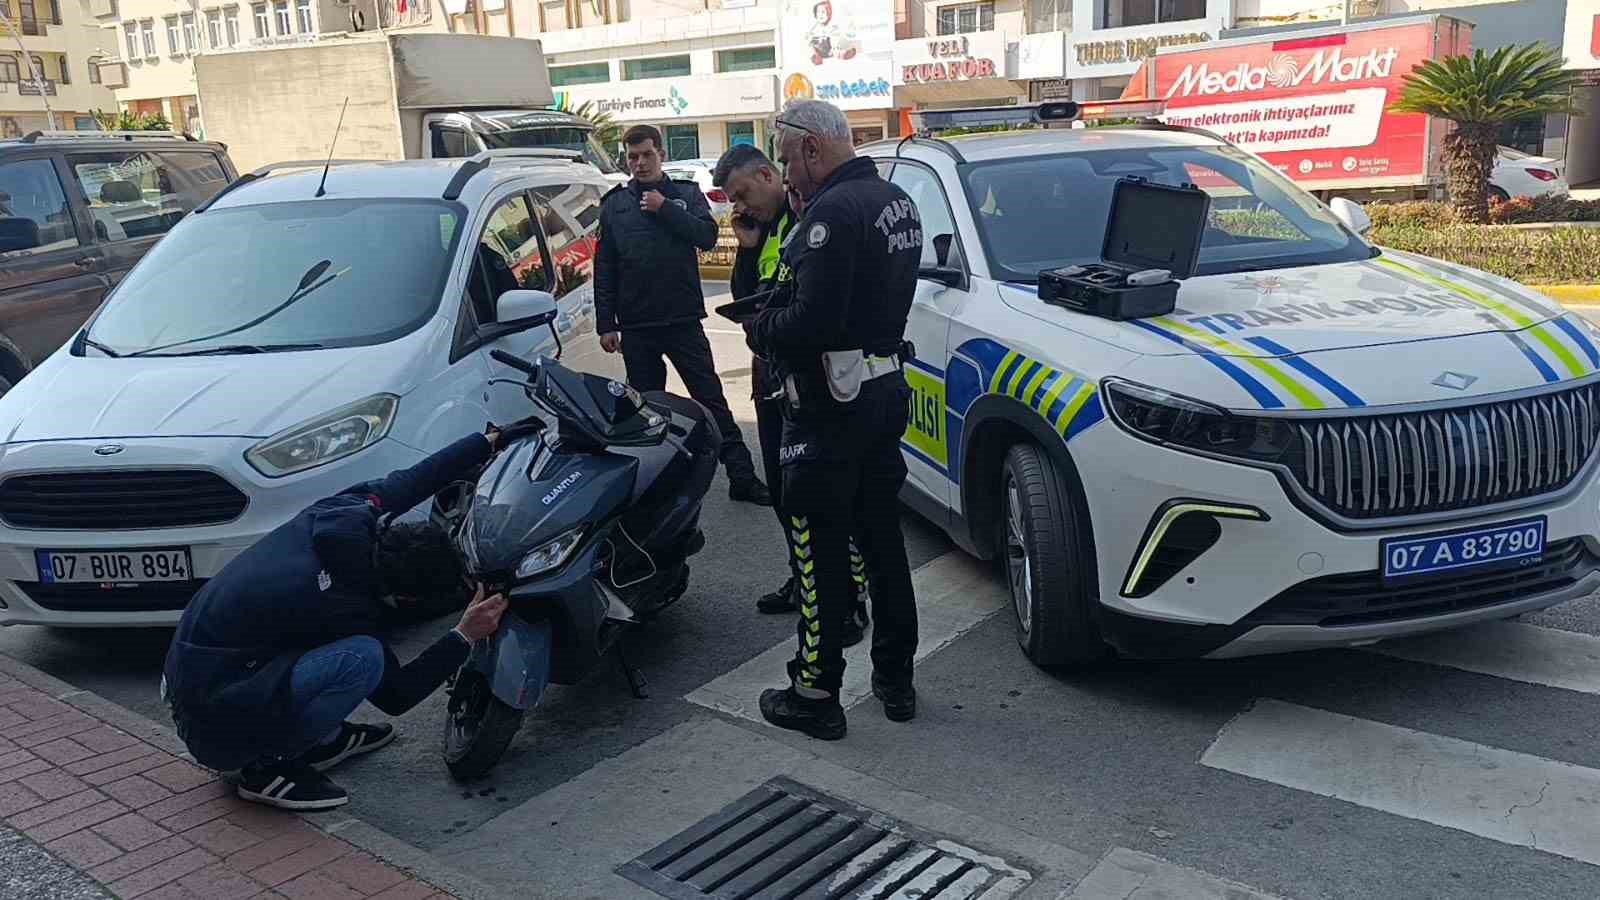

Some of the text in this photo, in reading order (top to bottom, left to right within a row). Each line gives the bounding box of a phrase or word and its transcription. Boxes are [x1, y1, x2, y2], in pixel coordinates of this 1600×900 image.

[902, 56, 997, 83] KUAFÖR
[597, 96, 666, 112] Türkiye Finans
[1193, 109, 1261, 126] elektronik
[1263, 103, 1355, 121] ihtiyaçlarınız
[1258, 124, 1331, 144] kapınızda!
[874, 197, 919, 236] TRAFİ
[906, 385, 940, 441] LİSİ
[542, 471, 582, 504] QUANTUM
[1392, 528, 1538, 569] 07 A 83790
[52, 555, 76, 579] 07
[90, 555, 134, 579] BUR
[142, 553, 185, 578] 894
